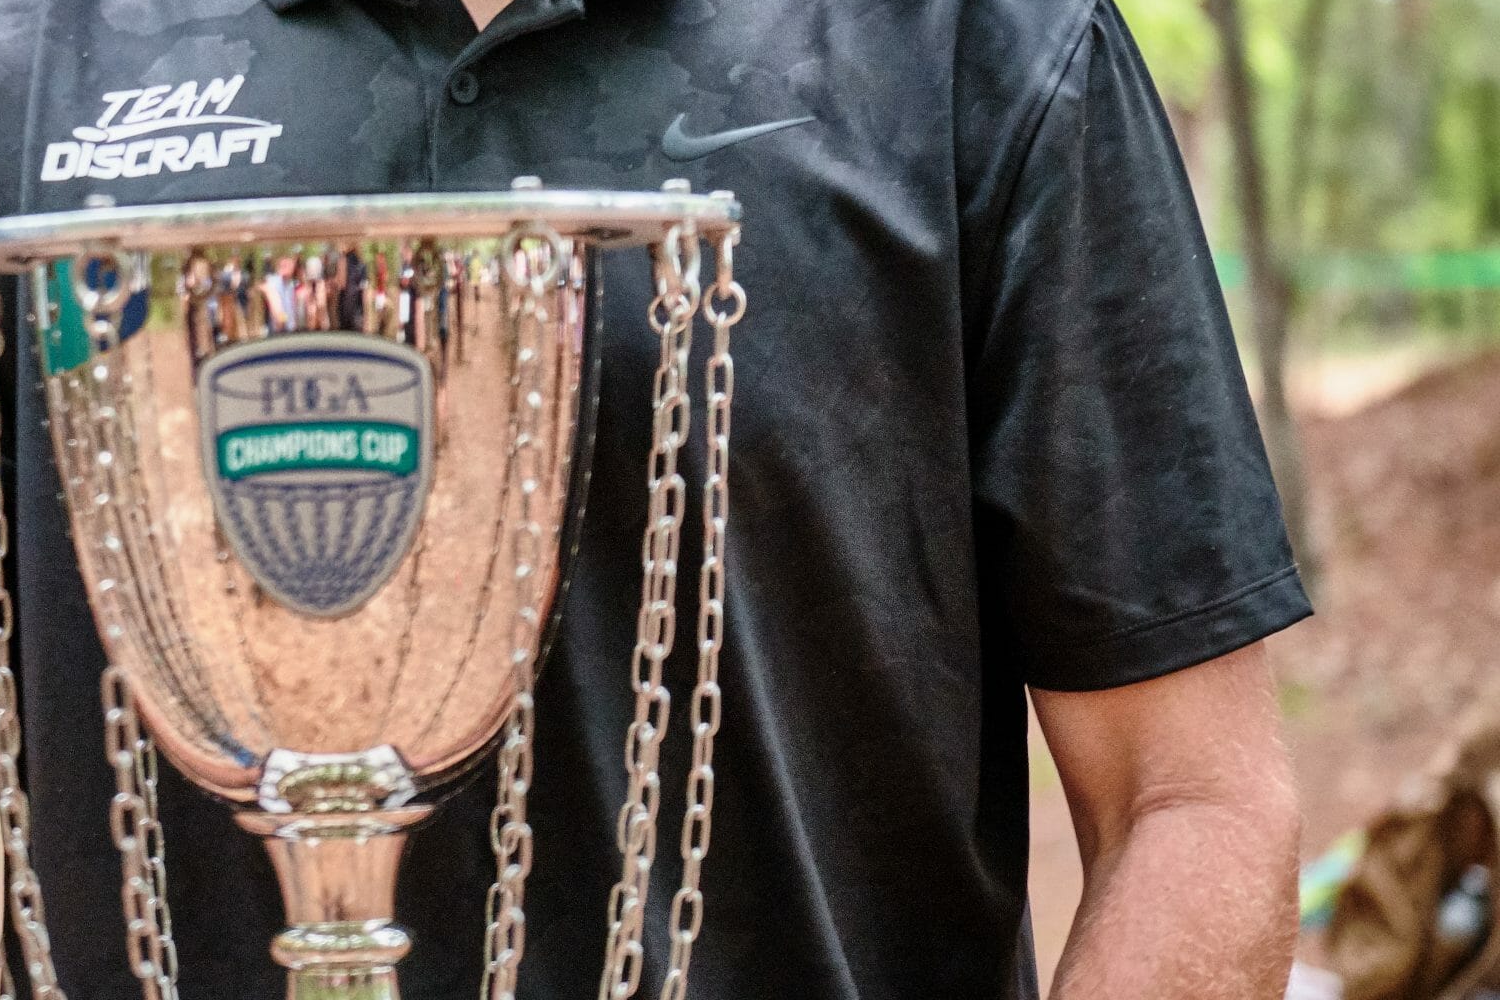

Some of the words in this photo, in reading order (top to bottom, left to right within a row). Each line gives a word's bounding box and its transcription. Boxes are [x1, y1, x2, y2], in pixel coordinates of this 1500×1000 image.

[96, 74, 244, 128] TEAM
[40, 124, 283, 182] DISCRAFT
[261, 372, 369, 415] PDGA
[225, 428, 359, 472] CHAMPIONS
[360, 428, 409, 465] CUP
